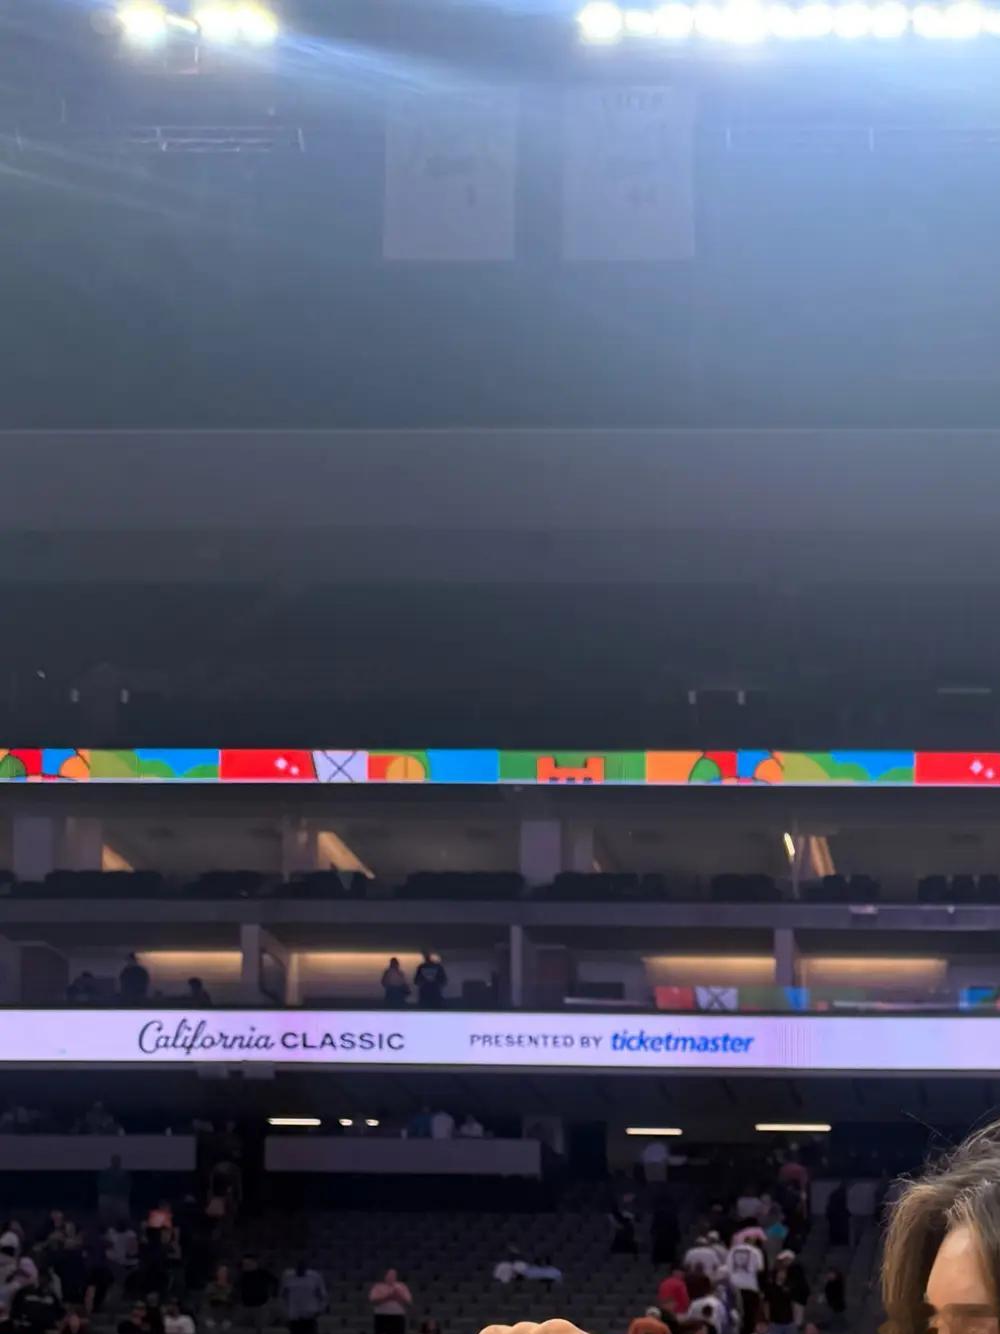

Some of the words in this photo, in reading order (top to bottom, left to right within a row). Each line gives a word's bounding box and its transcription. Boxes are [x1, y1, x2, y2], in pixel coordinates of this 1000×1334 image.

[138, 1017, 275, 1055] California
[280, 1031, 406, 1051] CLASSIC
[469, 1033, 575, 1048] PRESENTED
[581, 1035, 602, 1048] BY
[611, 1029, 754, 1053] ticketmaster
